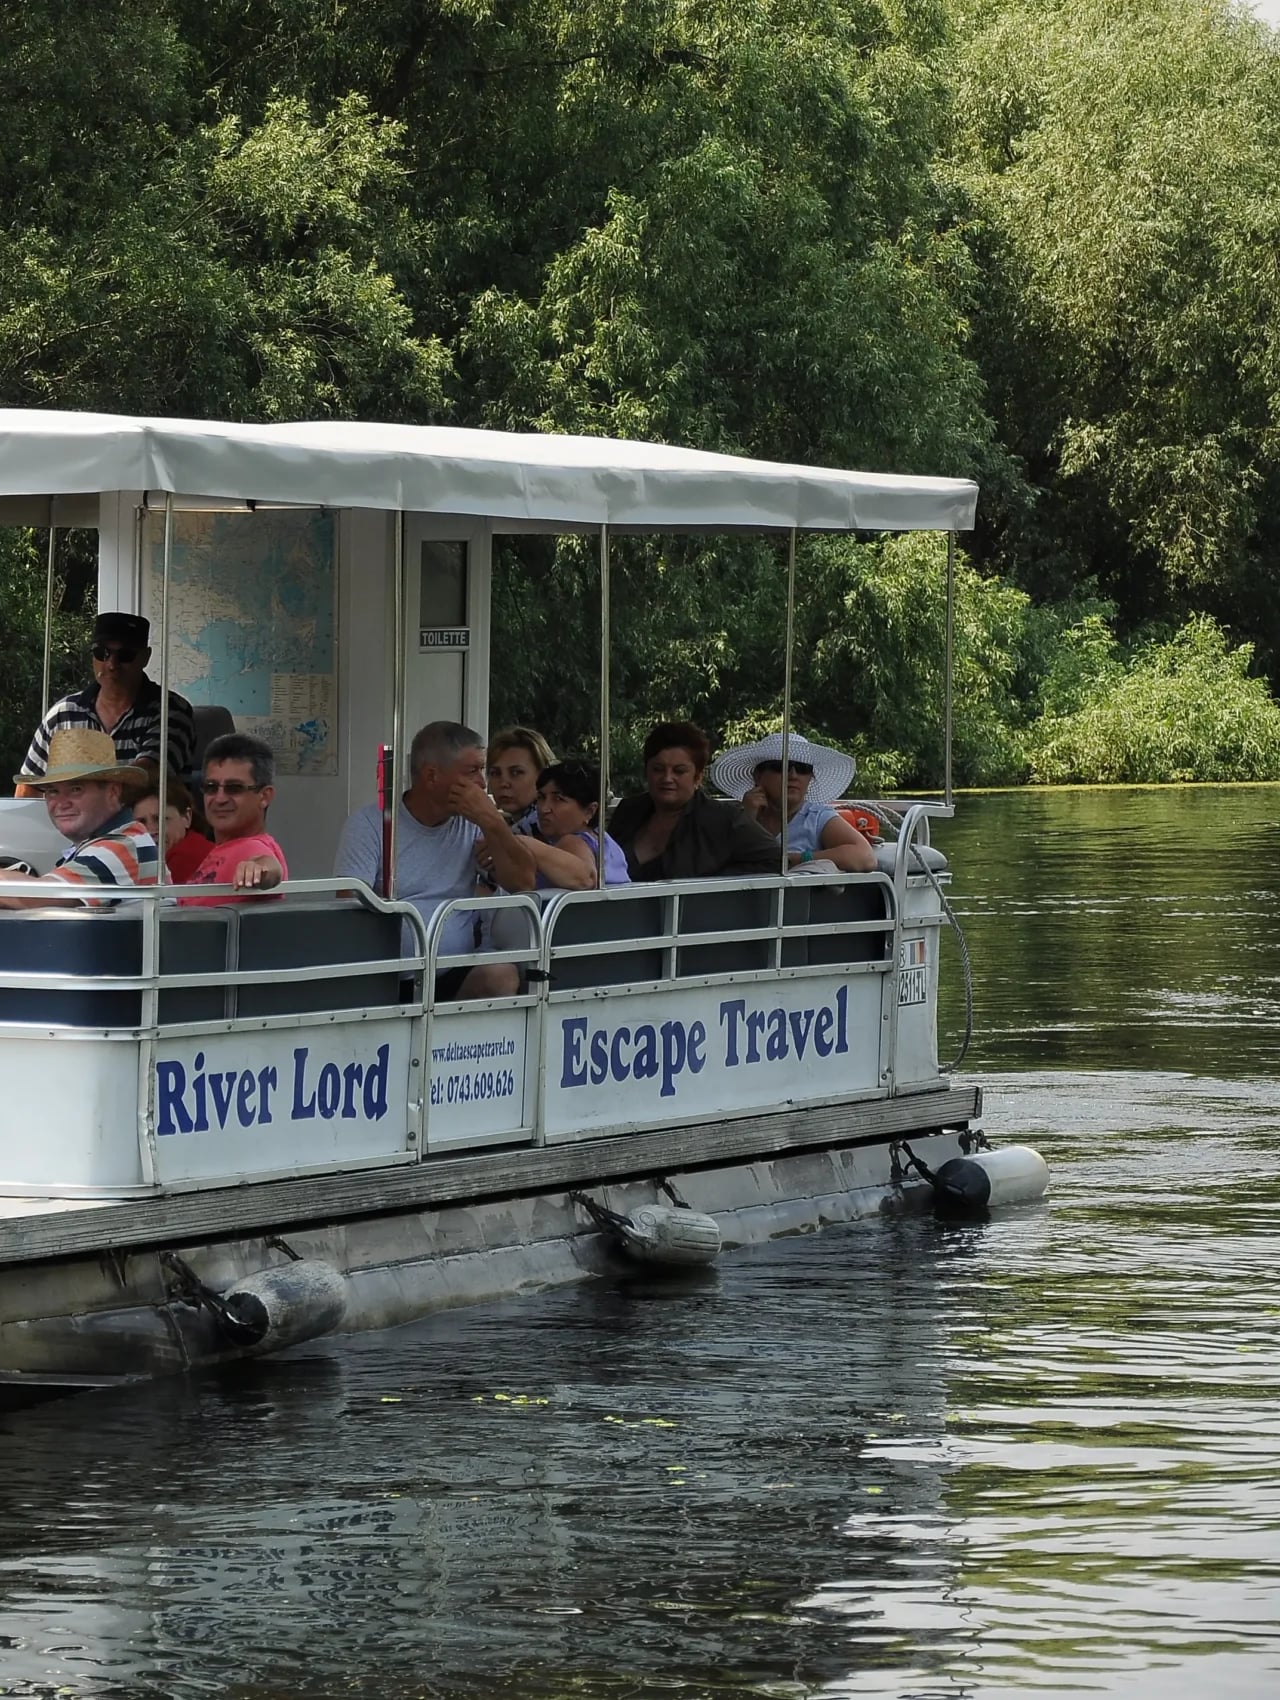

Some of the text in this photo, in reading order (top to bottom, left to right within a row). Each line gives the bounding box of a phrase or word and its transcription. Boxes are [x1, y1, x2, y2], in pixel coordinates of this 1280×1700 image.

[422, 631, 466, 645] TOILETTE
[431, 1036, 515, 1064] ww.deltaescapetravel.ro
[560, 984, 849, 1098] Escape Travel
[155, 1043, 390, 1137] River Lord
[447, 1068, 514, 1105] 0743.609.626
